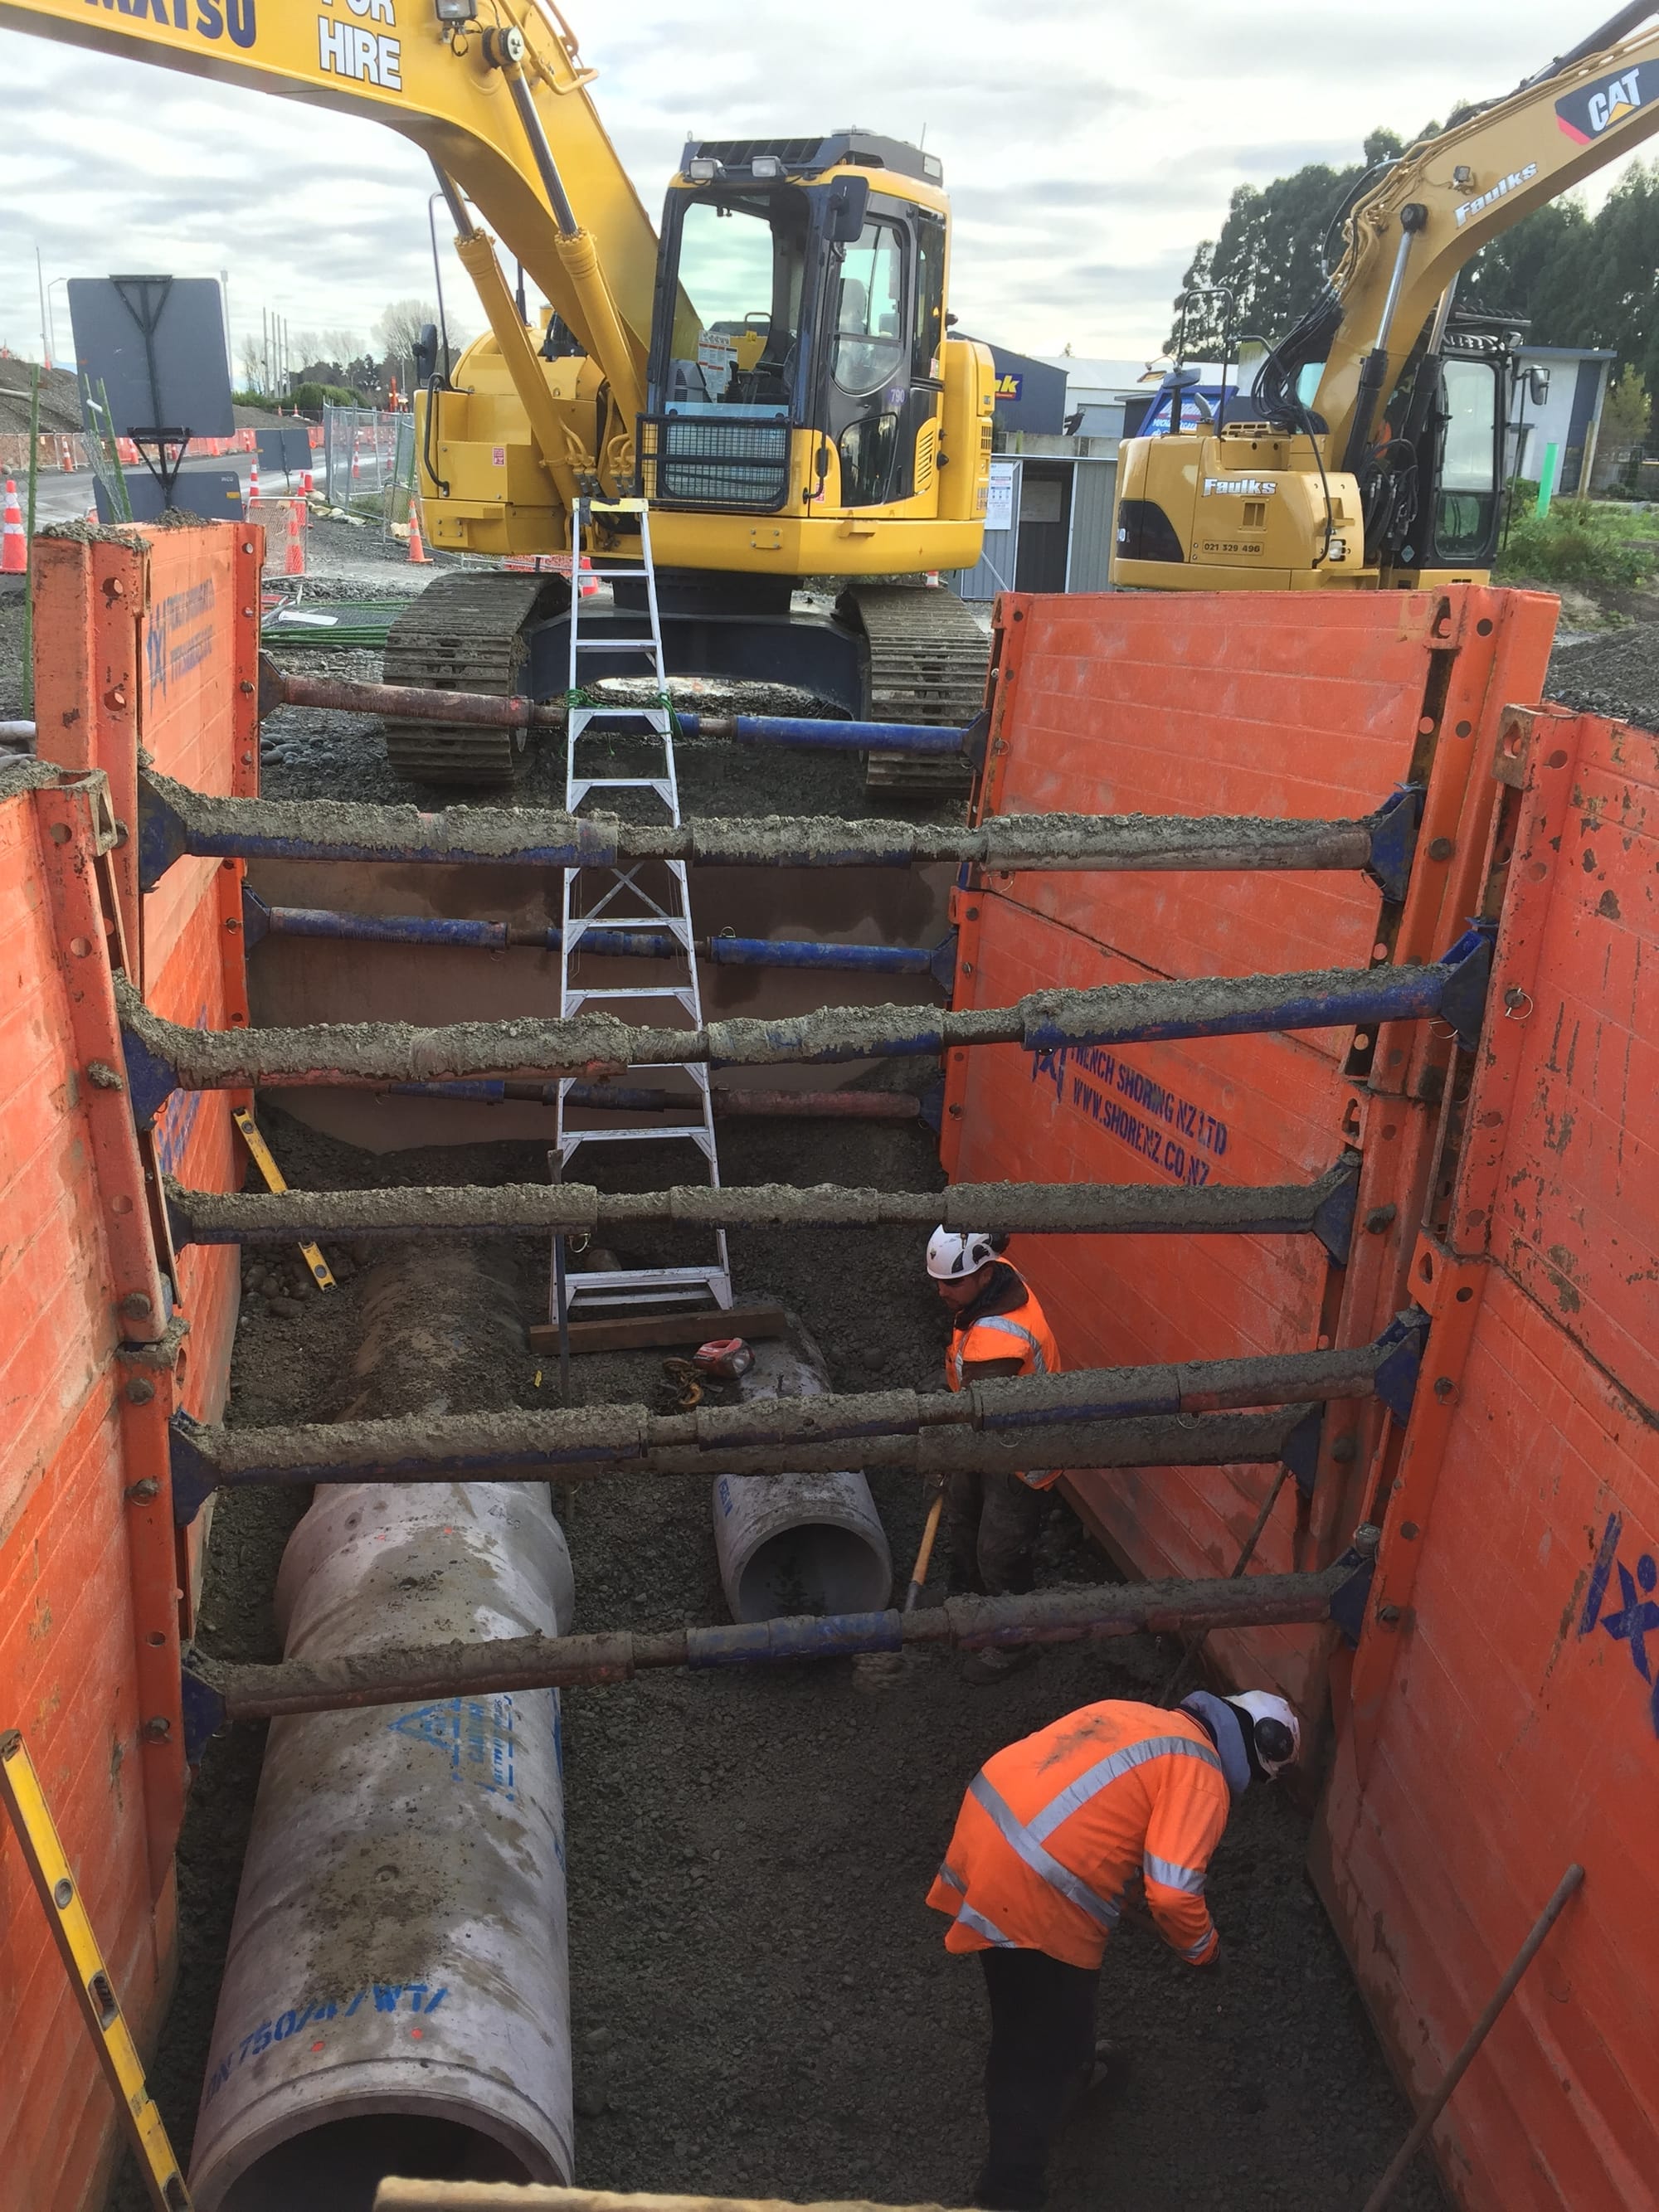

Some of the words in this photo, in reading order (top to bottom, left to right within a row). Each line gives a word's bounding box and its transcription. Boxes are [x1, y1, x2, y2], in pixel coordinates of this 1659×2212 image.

[319, 14, 402, 92] HIRE
[1588, 68, 1641, 132] CAT
[1453, 161, 1539, 229] Faulks
[890, 388, 905, 403] 790
[1202, 478, 1278, 498] Faulks
[1204, 542, 1219, 552] 021
[1223, 544, 1238, 552] 329
[1117, 1062, 1175, 1124] SHORING
[1175, 1098, 1197, 1138] NZ
[1196, 1110, 1228, 1156] LTD
